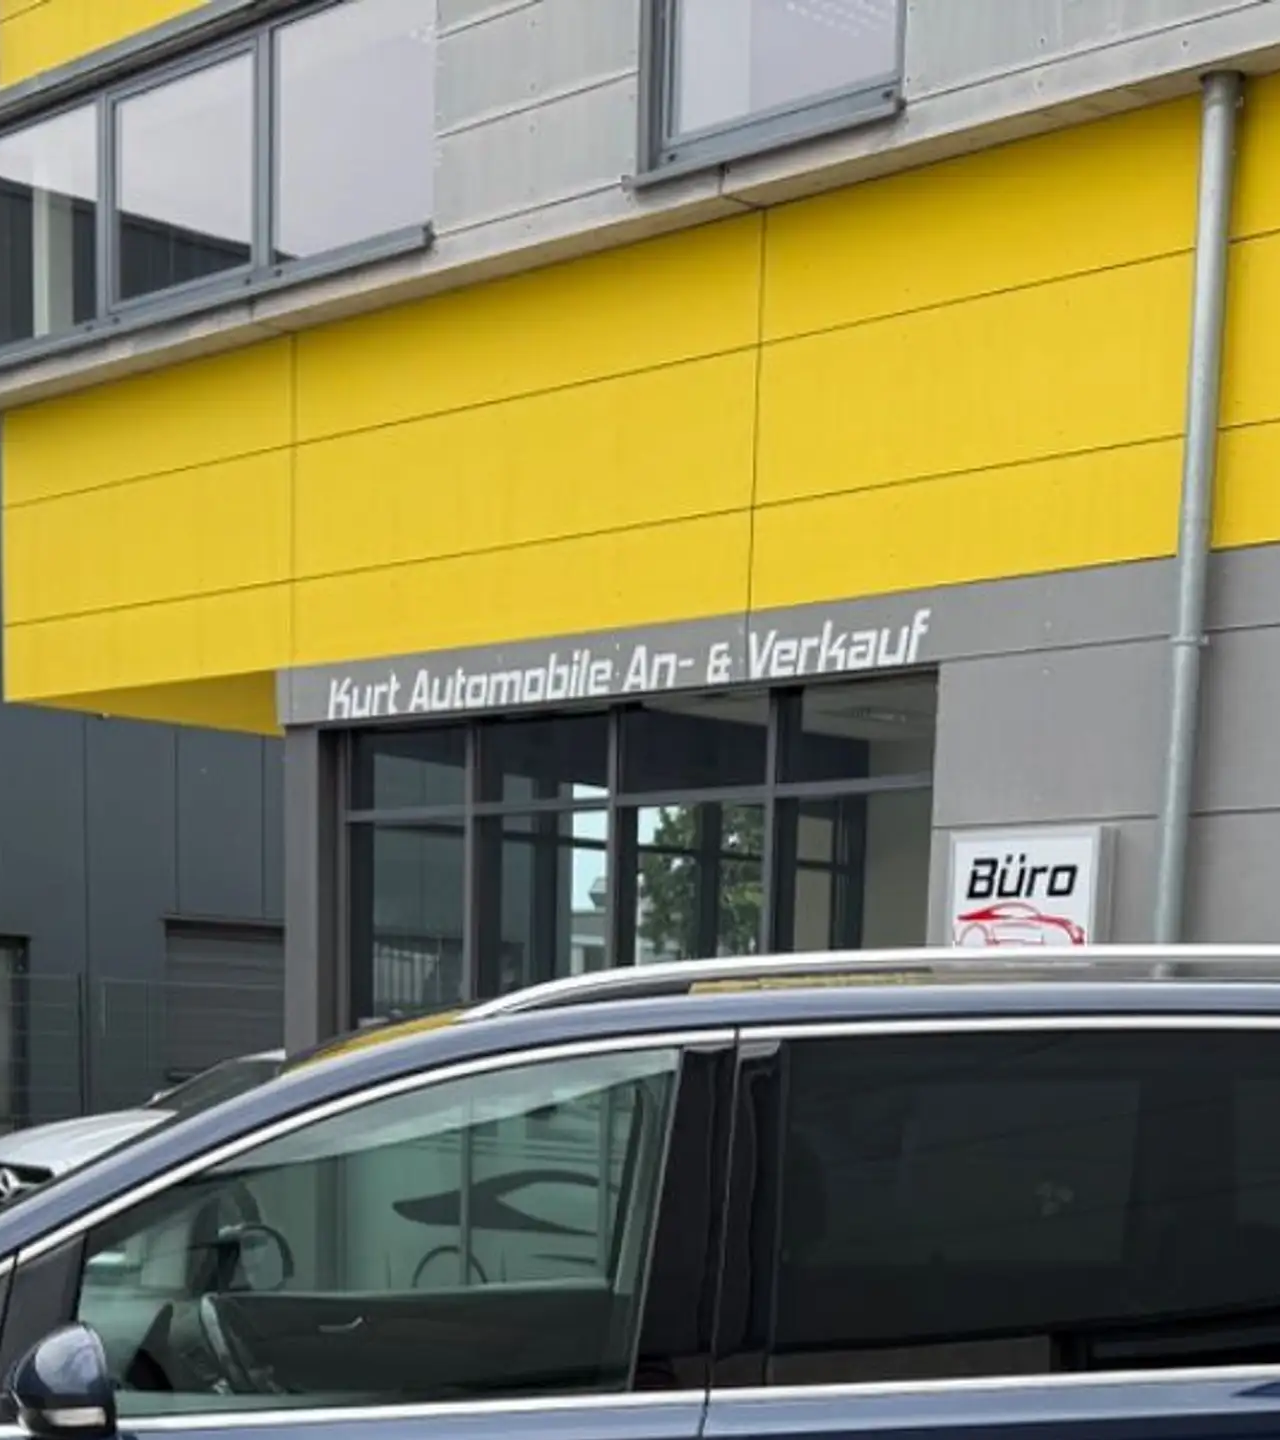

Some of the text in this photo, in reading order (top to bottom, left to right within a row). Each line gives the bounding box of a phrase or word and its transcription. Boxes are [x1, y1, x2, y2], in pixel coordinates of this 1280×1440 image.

[327, 608, 932, 720] Kurt Automobile An- & Verkauf
[966, 853, 1078, 899] Büro
